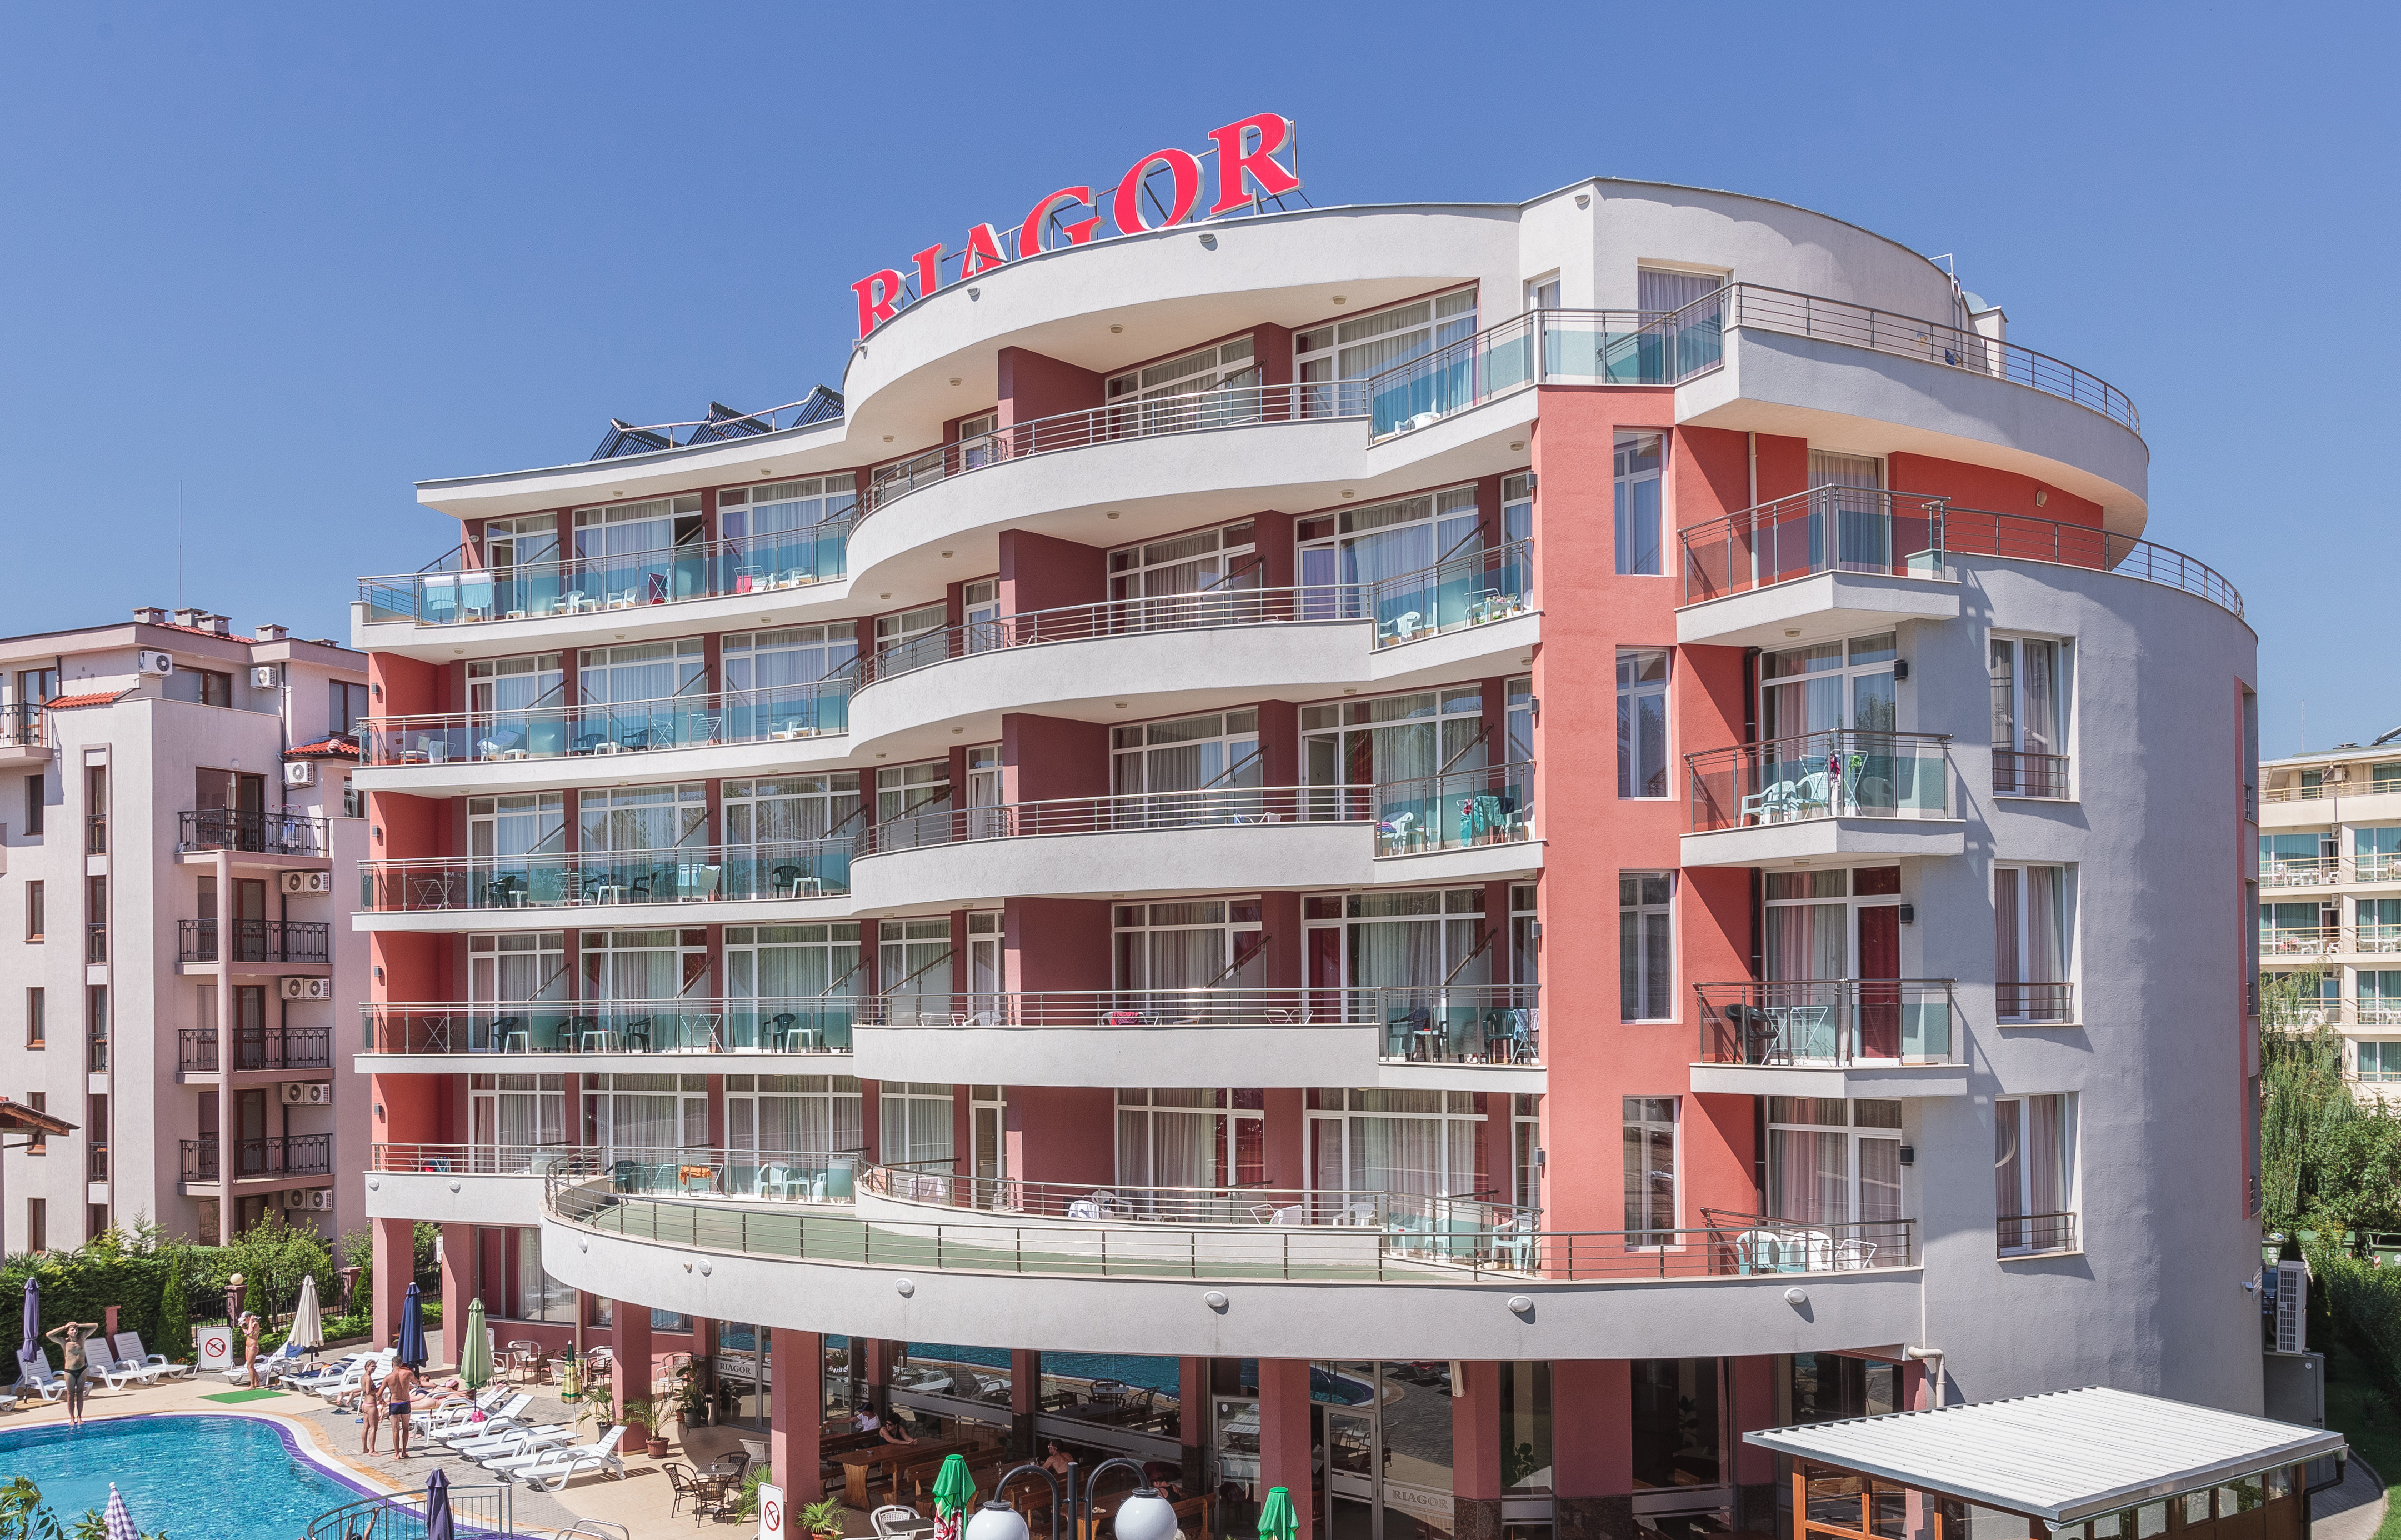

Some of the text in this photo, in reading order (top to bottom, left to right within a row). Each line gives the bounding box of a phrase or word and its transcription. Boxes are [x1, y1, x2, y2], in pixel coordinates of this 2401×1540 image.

[851, 112, 1301, 339] RIAGOR
[719, 1363, 751, 1374] RIAGOR
[1392, 1489, 1449, 1509] RIAGOR
